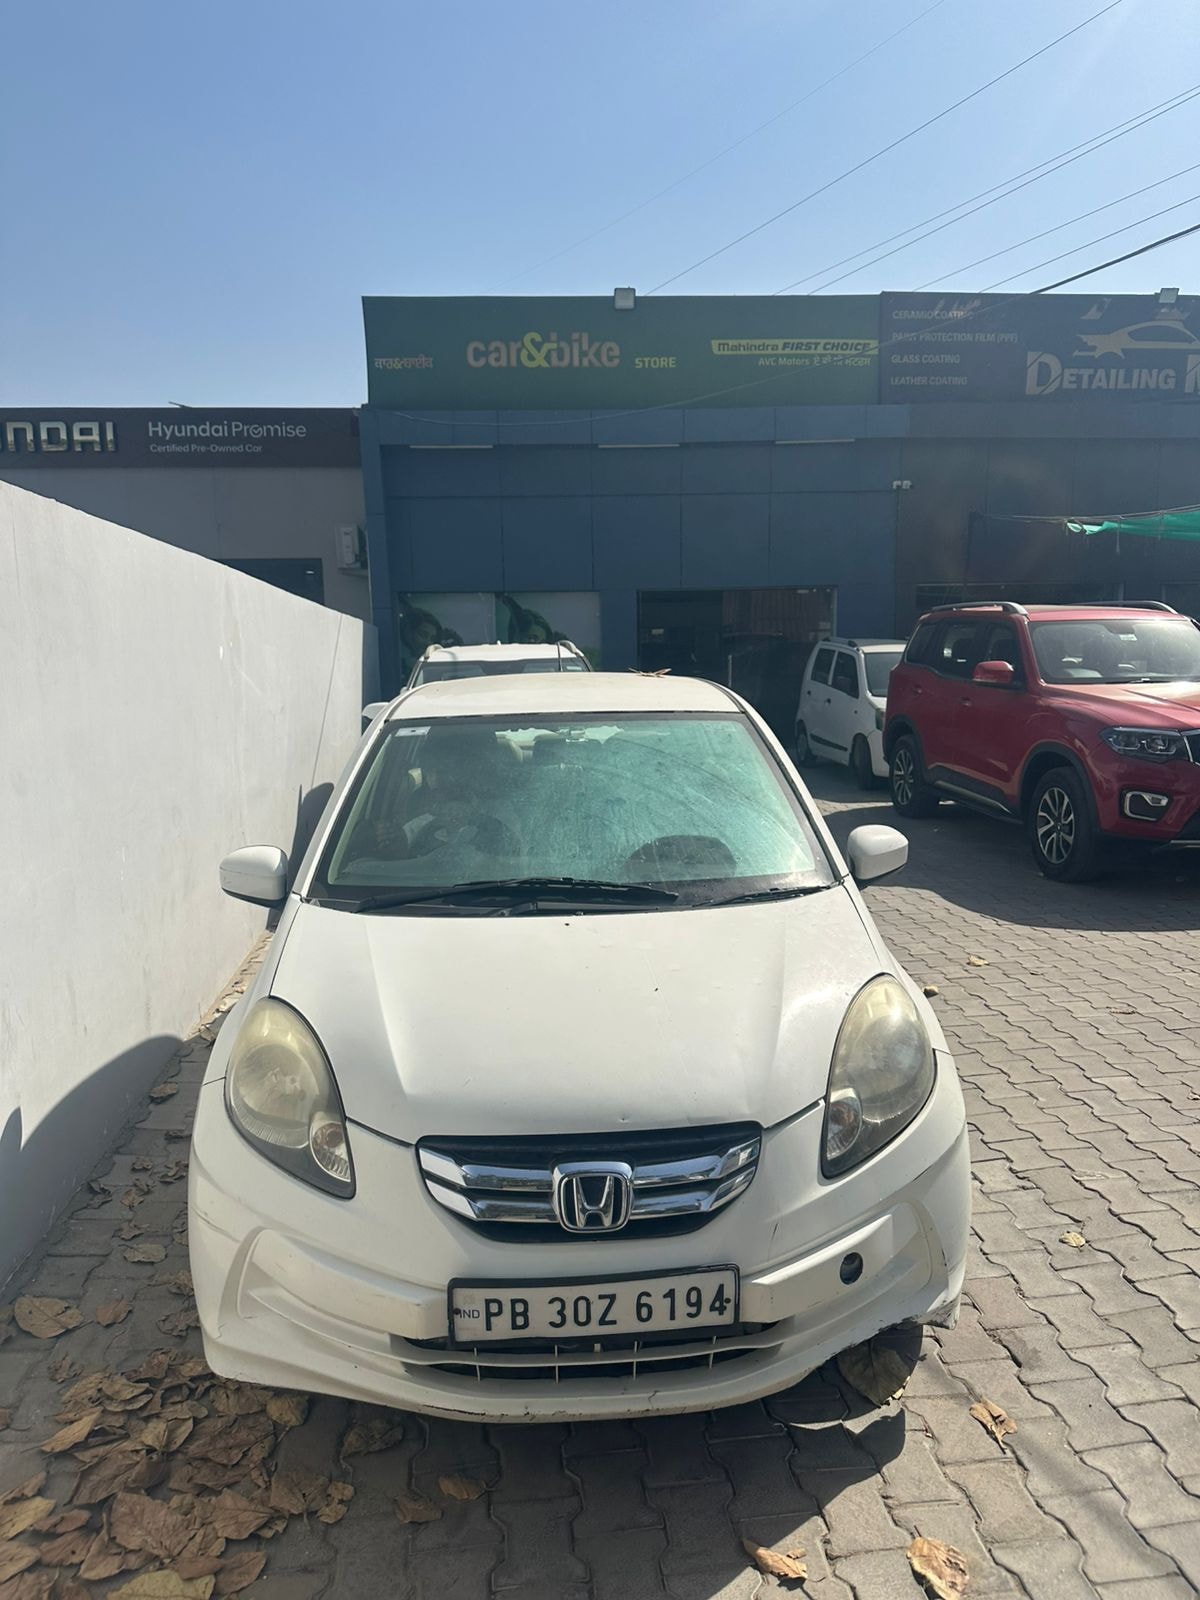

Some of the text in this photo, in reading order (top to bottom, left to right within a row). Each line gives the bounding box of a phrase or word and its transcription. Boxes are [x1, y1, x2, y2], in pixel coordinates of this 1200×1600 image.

[466, 331, 621, 369] car&bike
[717, 341, 870, 352] Mahindra FIRST CHOICE
[634, 357, 677, 369] STORE
[758, 357, 775, 366] AVC
[778, 356, 810, 367] Motors
[891, 354, 961, 364] GLASS COATING
[1025, 351, 1176, 396] DETAILING
[890, 376, 968, 386] LEATHER COATING
[148, 420, 307, 440] Hyundai Promise
[1, 421, 116, 452] NDAI
[149, 443, 262, 453] Certified Pre-Owned Car
[484, 1283, 727, 1331] PB 30Z 6194
